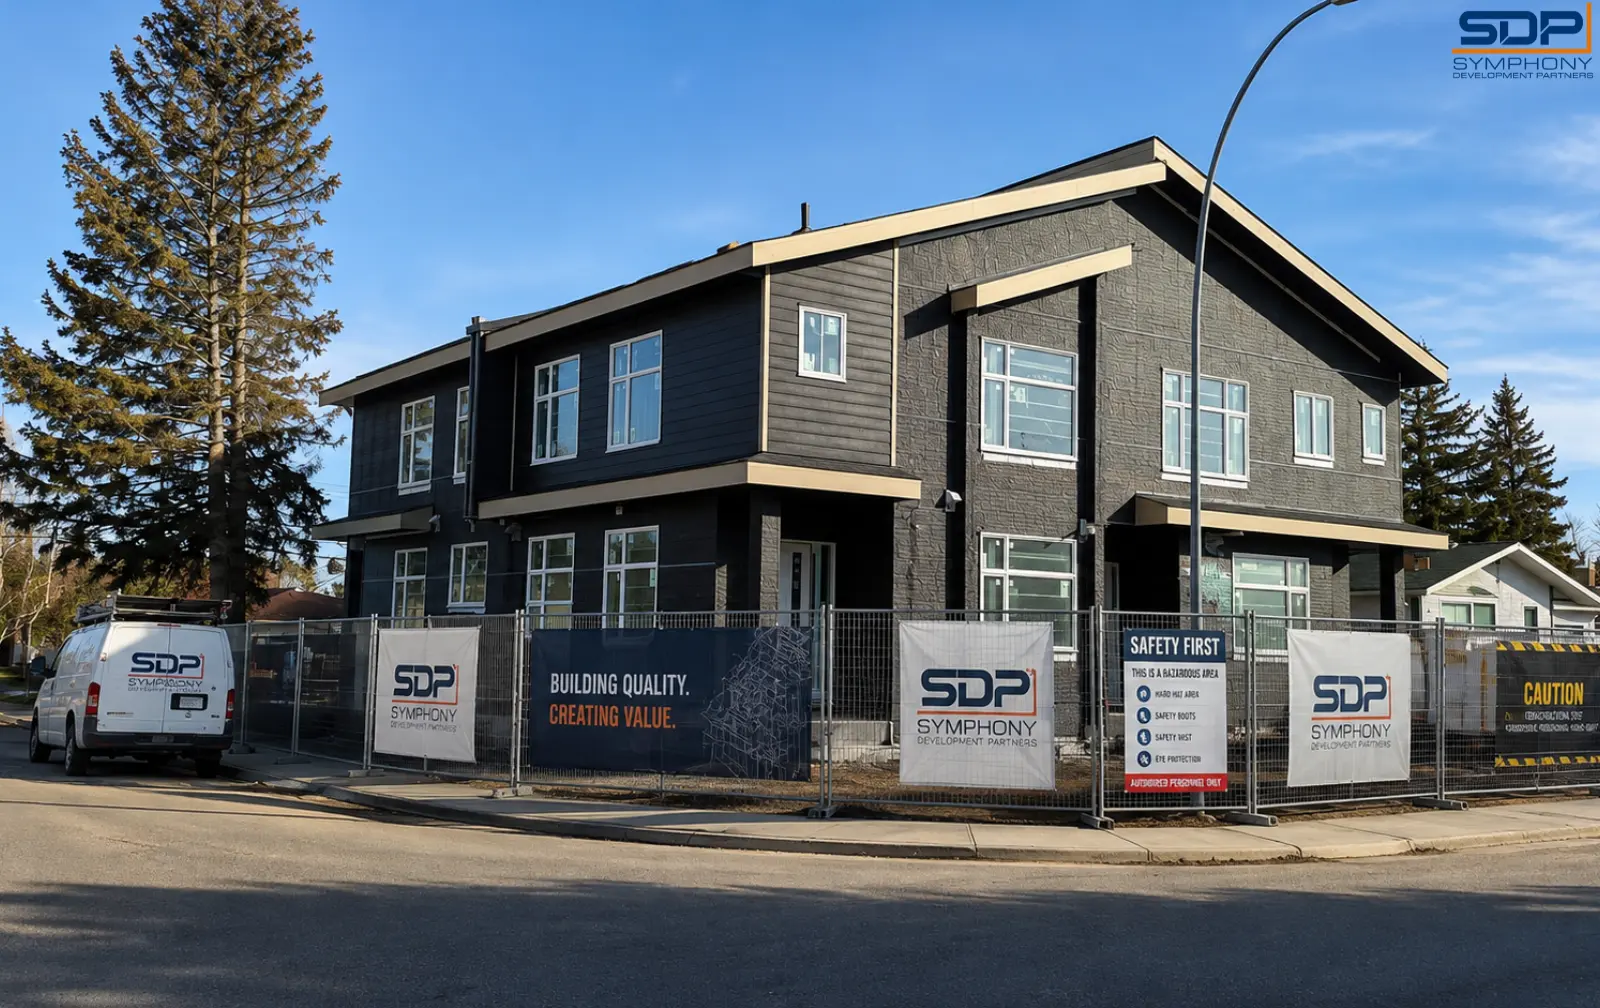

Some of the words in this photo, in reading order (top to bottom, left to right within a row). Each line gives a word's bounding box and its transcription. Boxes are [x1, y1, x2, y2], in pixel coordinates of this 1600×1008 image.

[1130, 636, 1179, 655] SAFETY
[1184, 637, 1220, 656] FIRST
[131, 652, 201, 674] SDP
[1132, 668, 1147, 678] THIS
[1148, 668, 1155, 678] IS
[1156, 668, 1162, 678] A
[393, 665, 455, 698] SDP
[550, 672, 618, 695] BUILDING
[623, 674, 690, 697] QUALITY.
[921, 668, 1031, 707] SDP
[1313, 675, 1388, 713] SDP
[1524, 681, 1584, 705] CAUTION
[391, 706, 458, 722] SYMPHONY
[549, 704, 619, 727] CREATING
[623, 706, 676, 729] VALUE.
[1155, 712, 1176, 720] SAFETY
[917, 719, 1038, 736] SYMPHONY
[1311, 723, 1392, 740] SYMPHONY
[917, 736, 984, 746] DEVELOPMENT
[988, 738, 1038, 748] PARTNERS
